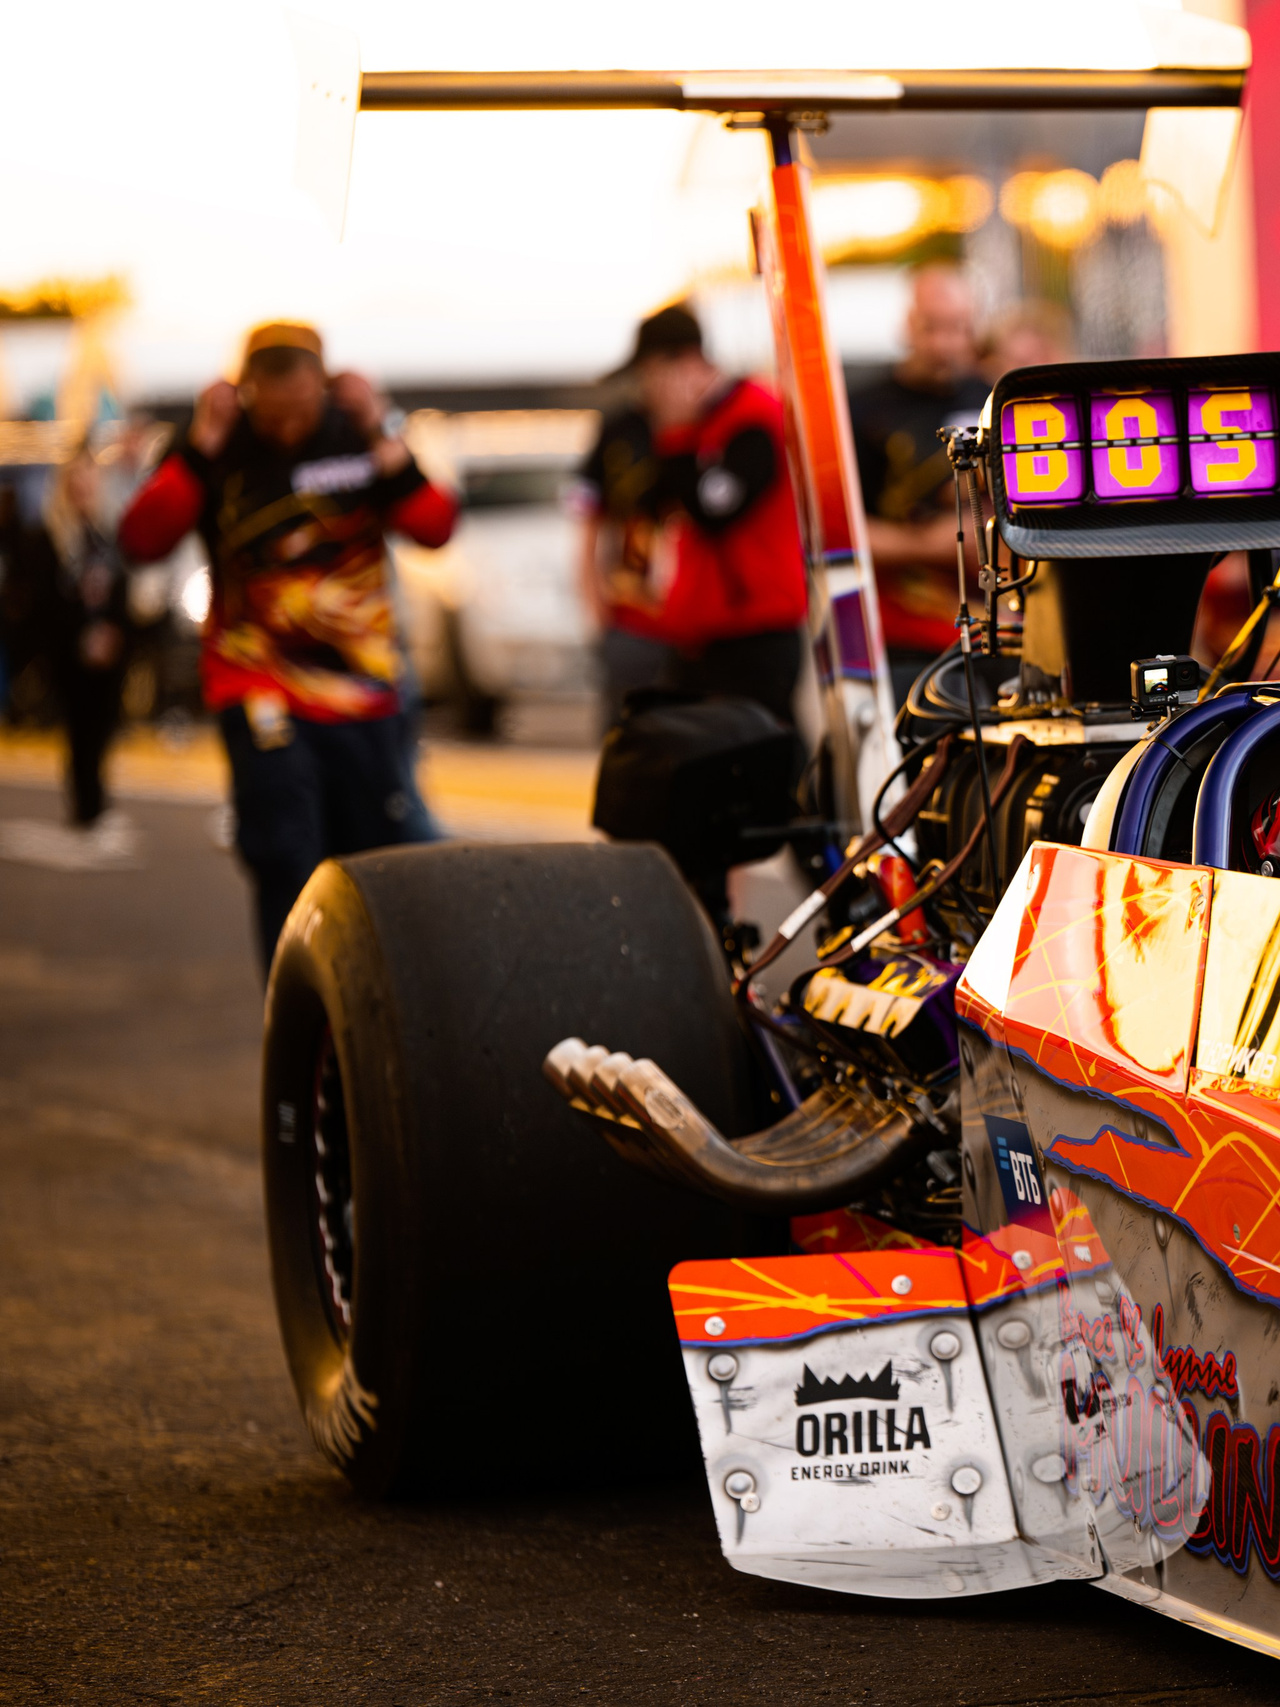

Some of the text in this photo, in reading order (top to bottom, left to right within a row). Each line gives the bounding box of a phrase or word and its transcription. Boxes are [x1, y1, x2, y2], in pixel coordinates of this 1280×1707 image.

[1009, 1150, 1042, 1205] ВТБ
[1152, 1302, 1239, 1407] Lynne
[795, 1406, 932, 1457] ORILLA
[790, 1460, 910, 1481] ENERGY DRINK
